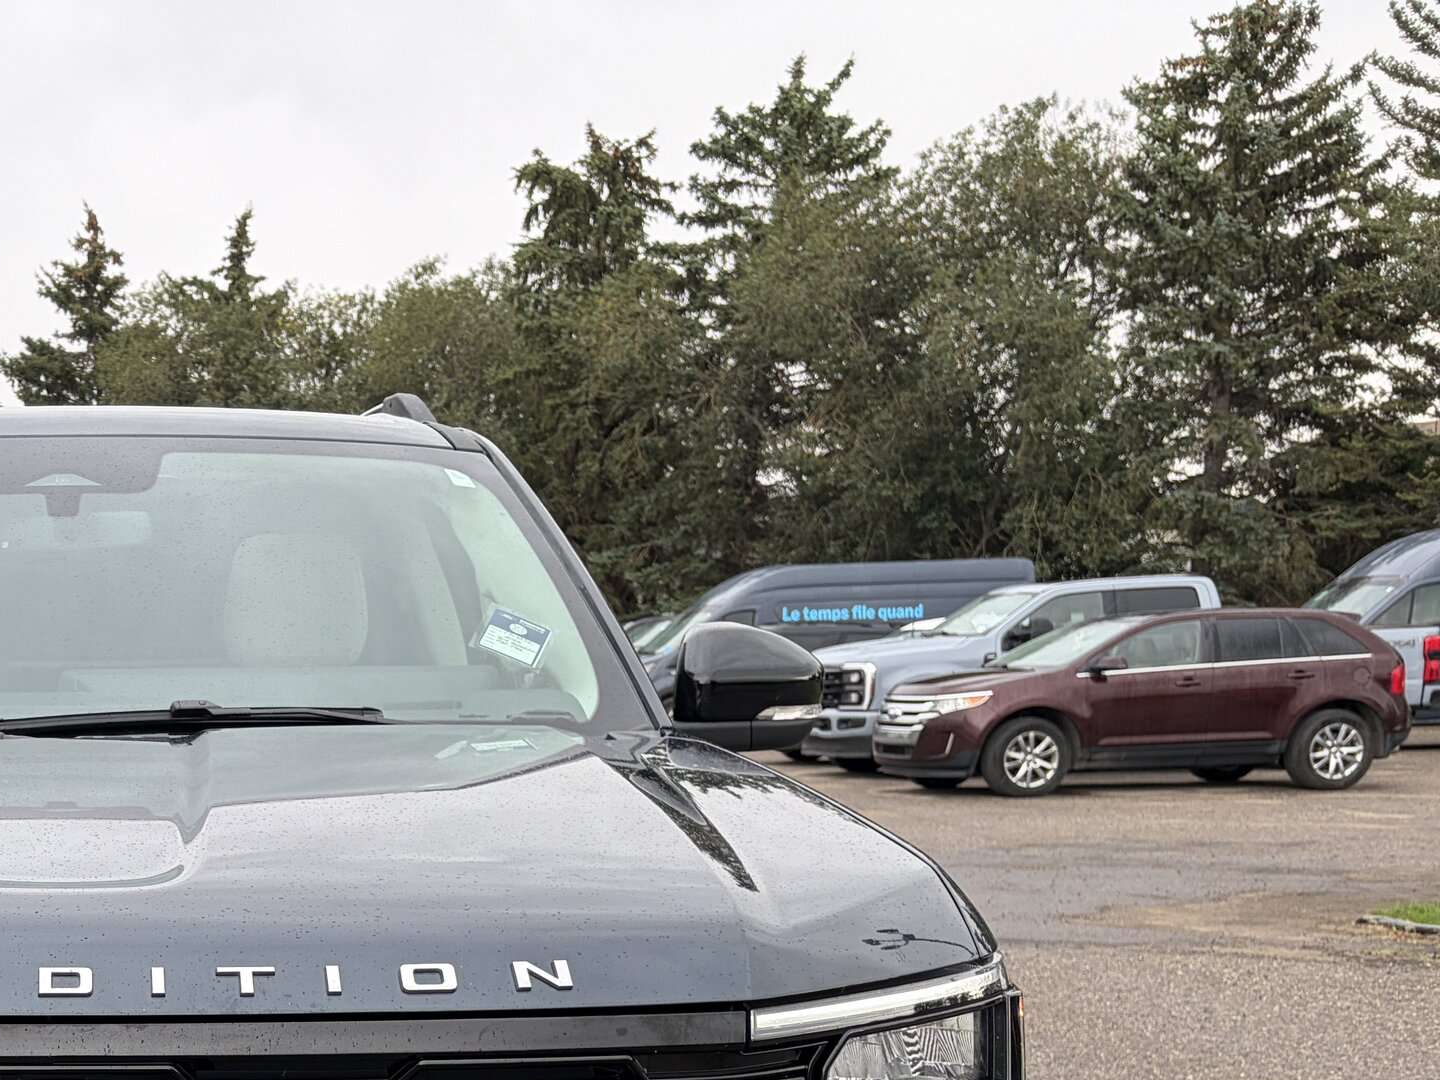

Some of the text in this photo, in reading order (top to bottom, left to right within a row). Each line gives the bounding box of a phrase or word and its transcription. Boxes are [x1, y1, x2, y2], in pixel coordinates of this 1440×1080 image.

[782, 603, 924, 622] Le temps file quand
